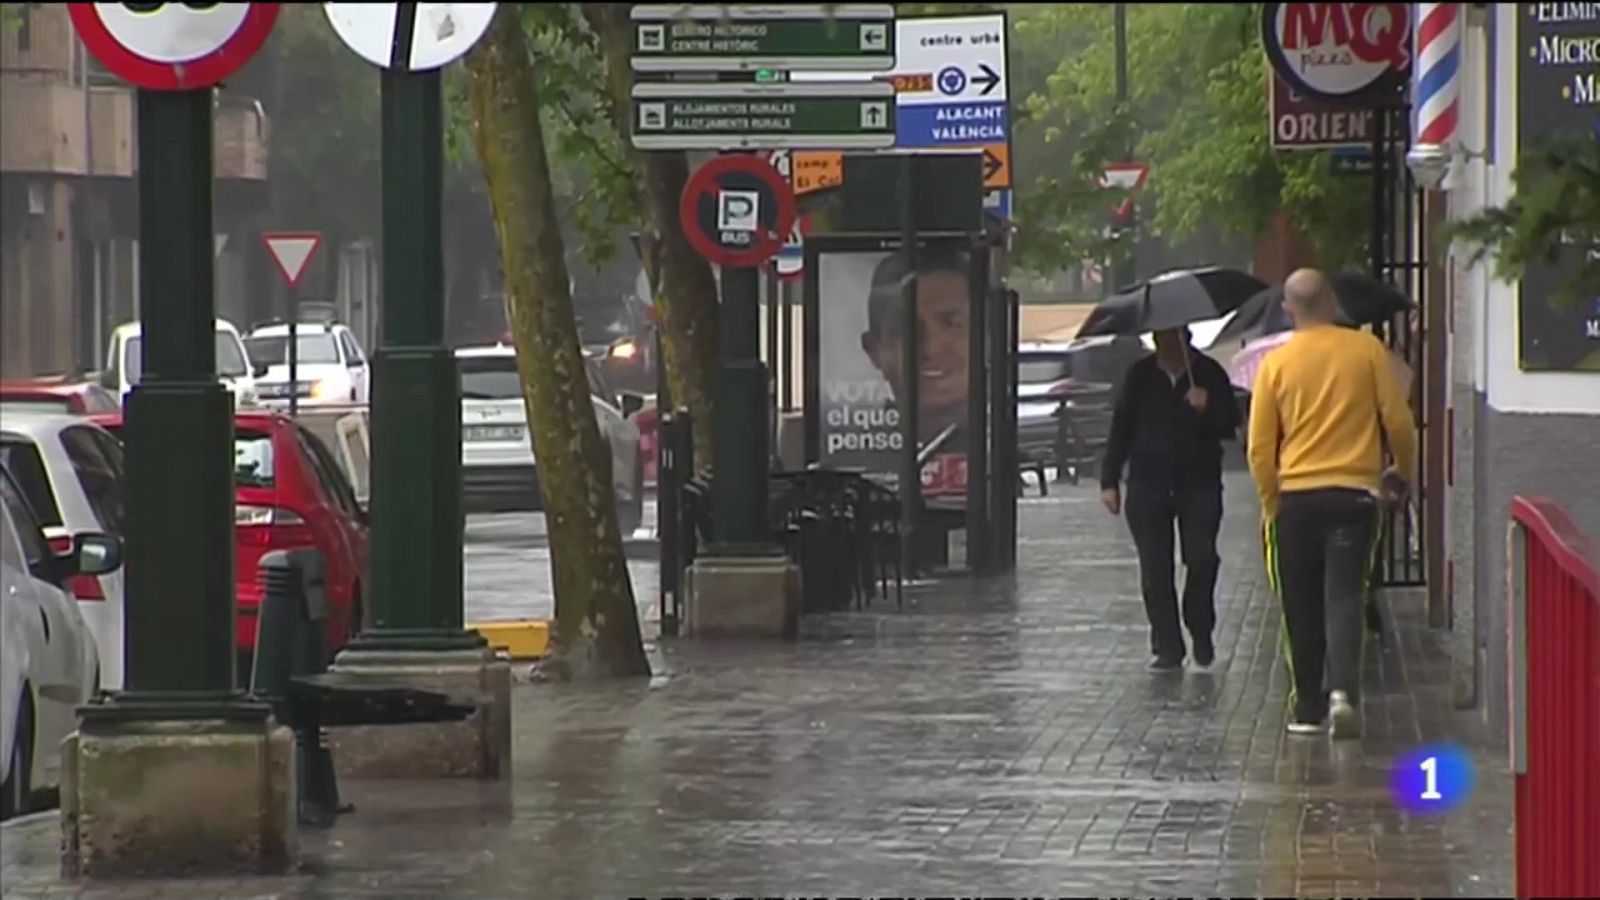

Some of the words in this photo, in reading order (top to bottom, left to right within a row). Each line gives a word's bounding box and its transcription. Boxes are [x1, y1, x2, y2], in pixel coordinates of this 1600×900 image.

[671, 39, 711, 51] CENTRE
[920, 34, 963, 47] centre
[750, 102, 796, 114] RURALES
[936, 106, 1003, 121] ALACANT
[751, 117, 791, 129] RURALS
[721, 231, 750, 244] BUS
[822, 379, 896, 402] VOTA
[827, 404, 850, 426] el
[853, 408, 900, 430] que
